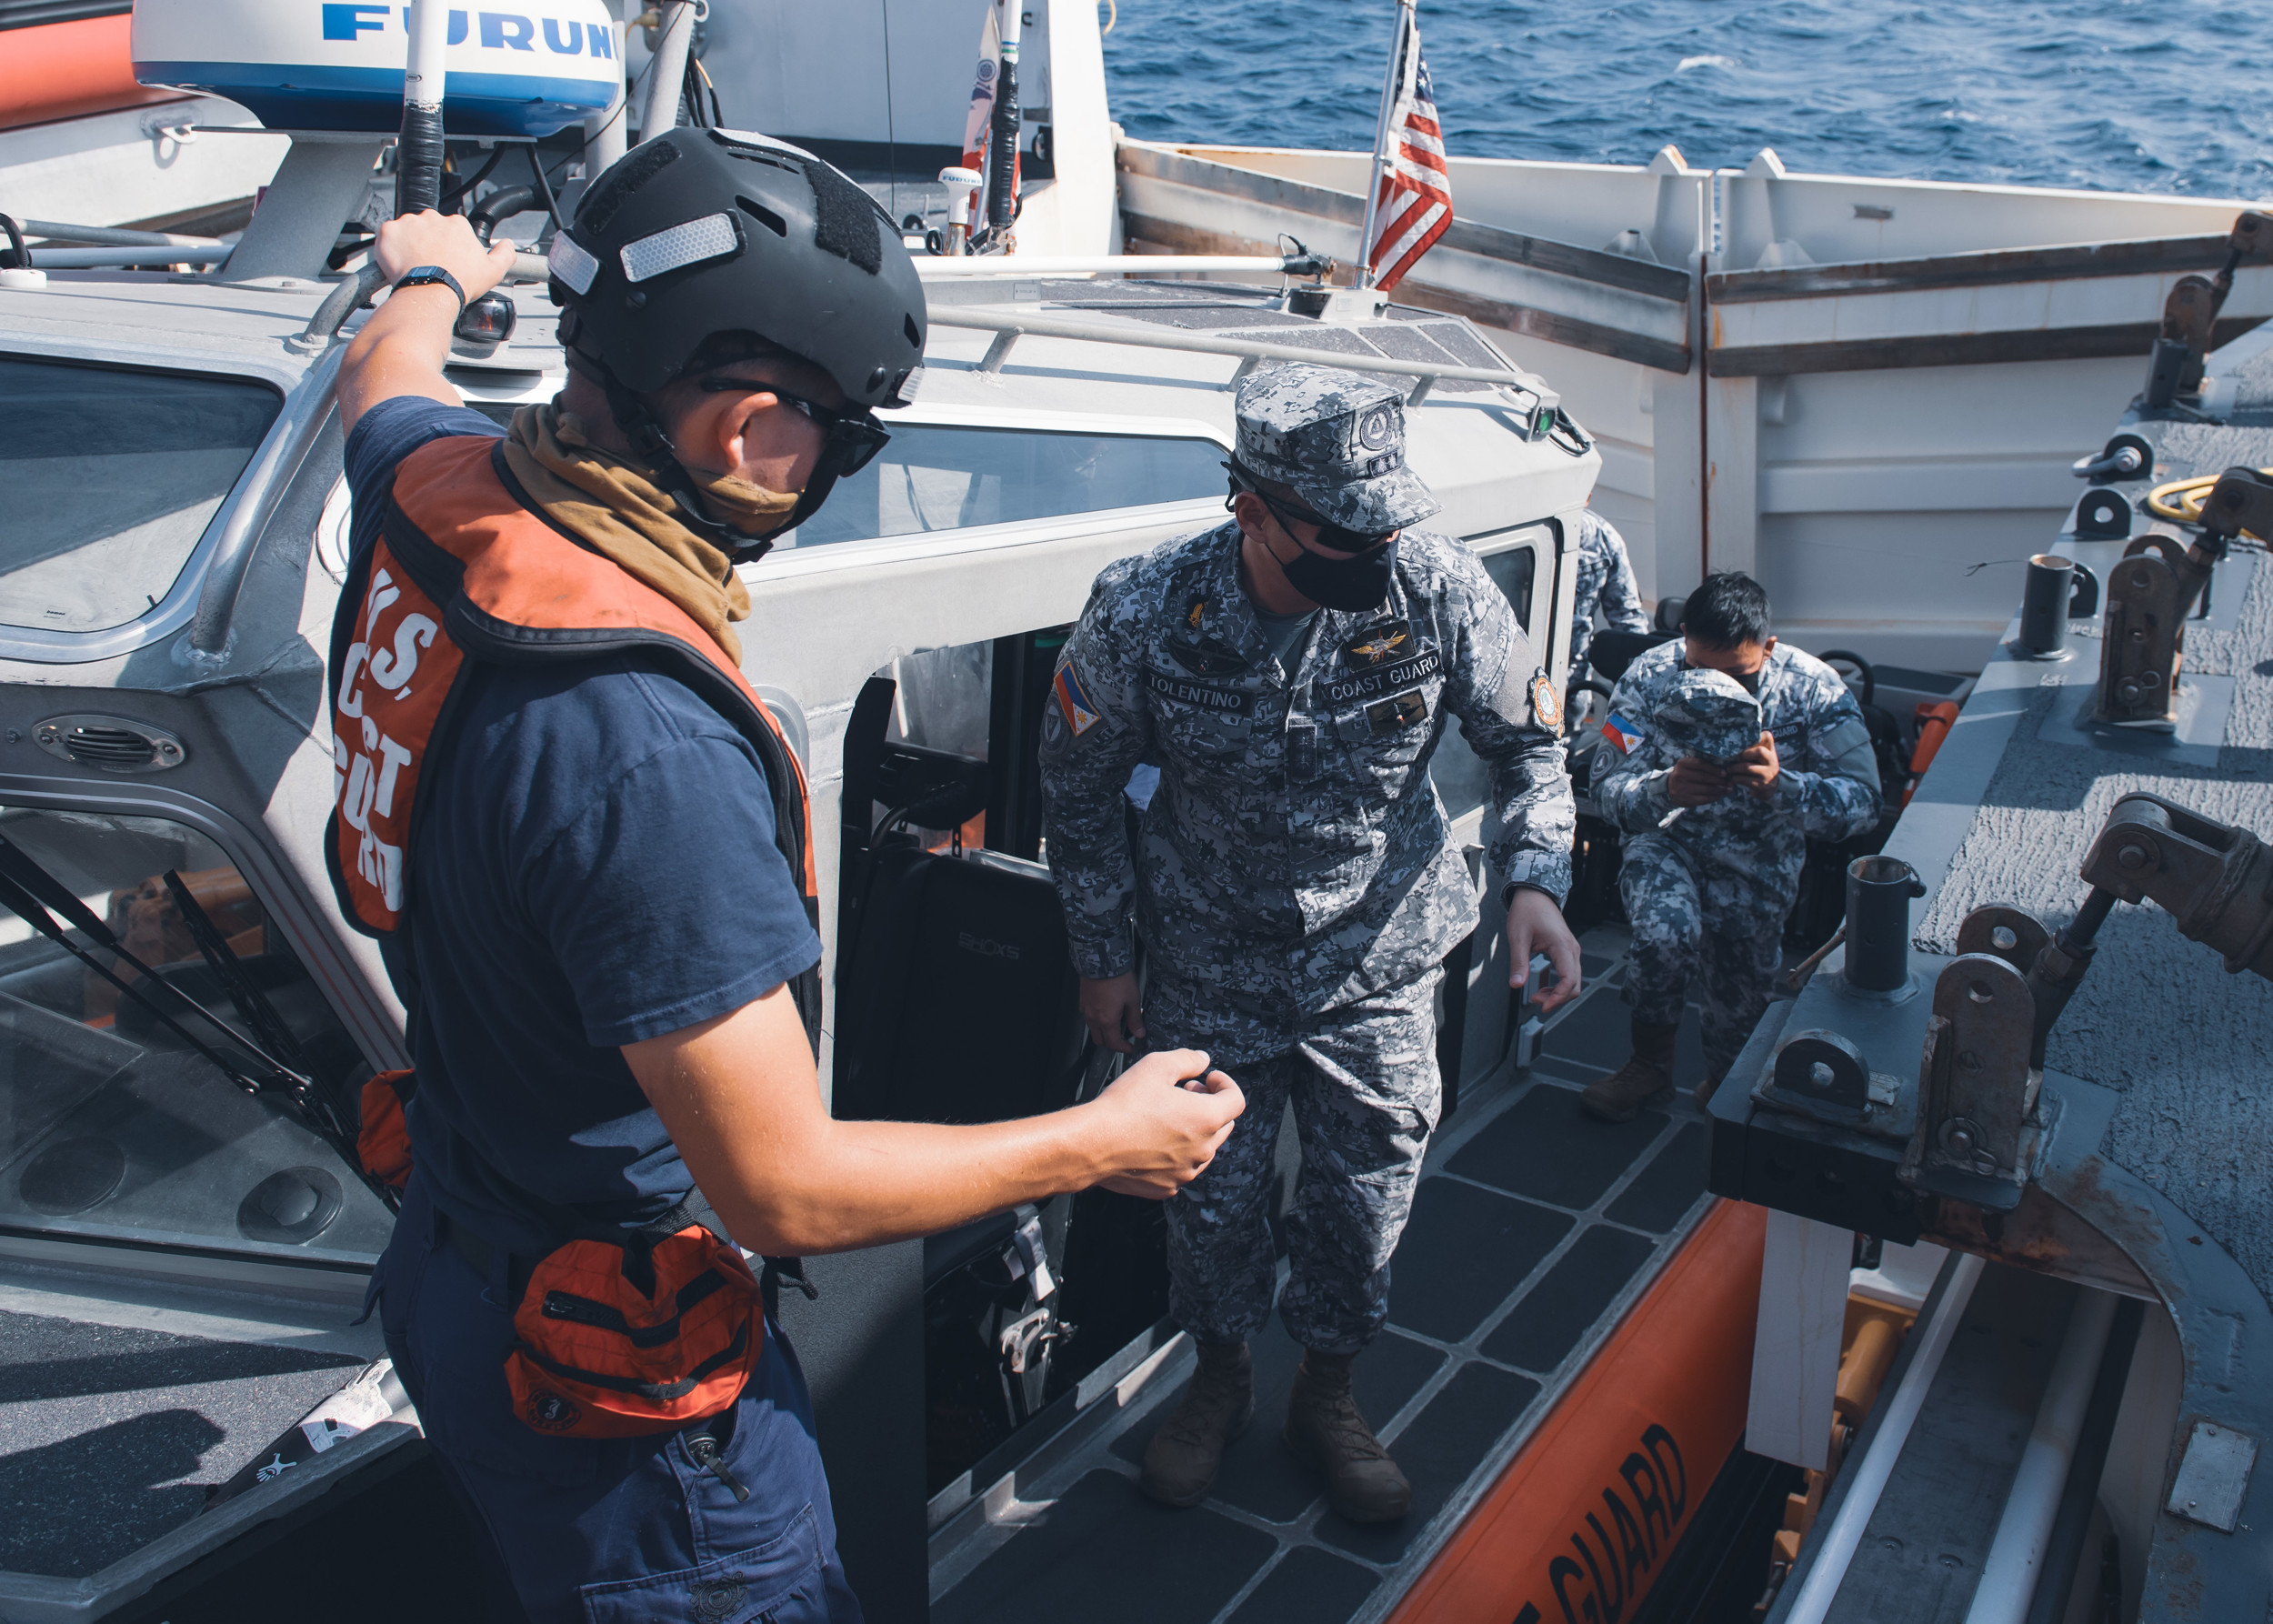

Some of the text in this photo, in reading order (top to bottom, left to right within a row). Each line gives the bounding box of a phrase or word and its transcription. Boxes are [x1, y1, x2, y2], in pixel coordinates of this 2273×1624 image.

[322, 3, 619, 61] FURUN
[1149, 674, 1241, 708] TOLENTINO
[1331, 656, 1438, 700] COAST GUARD
